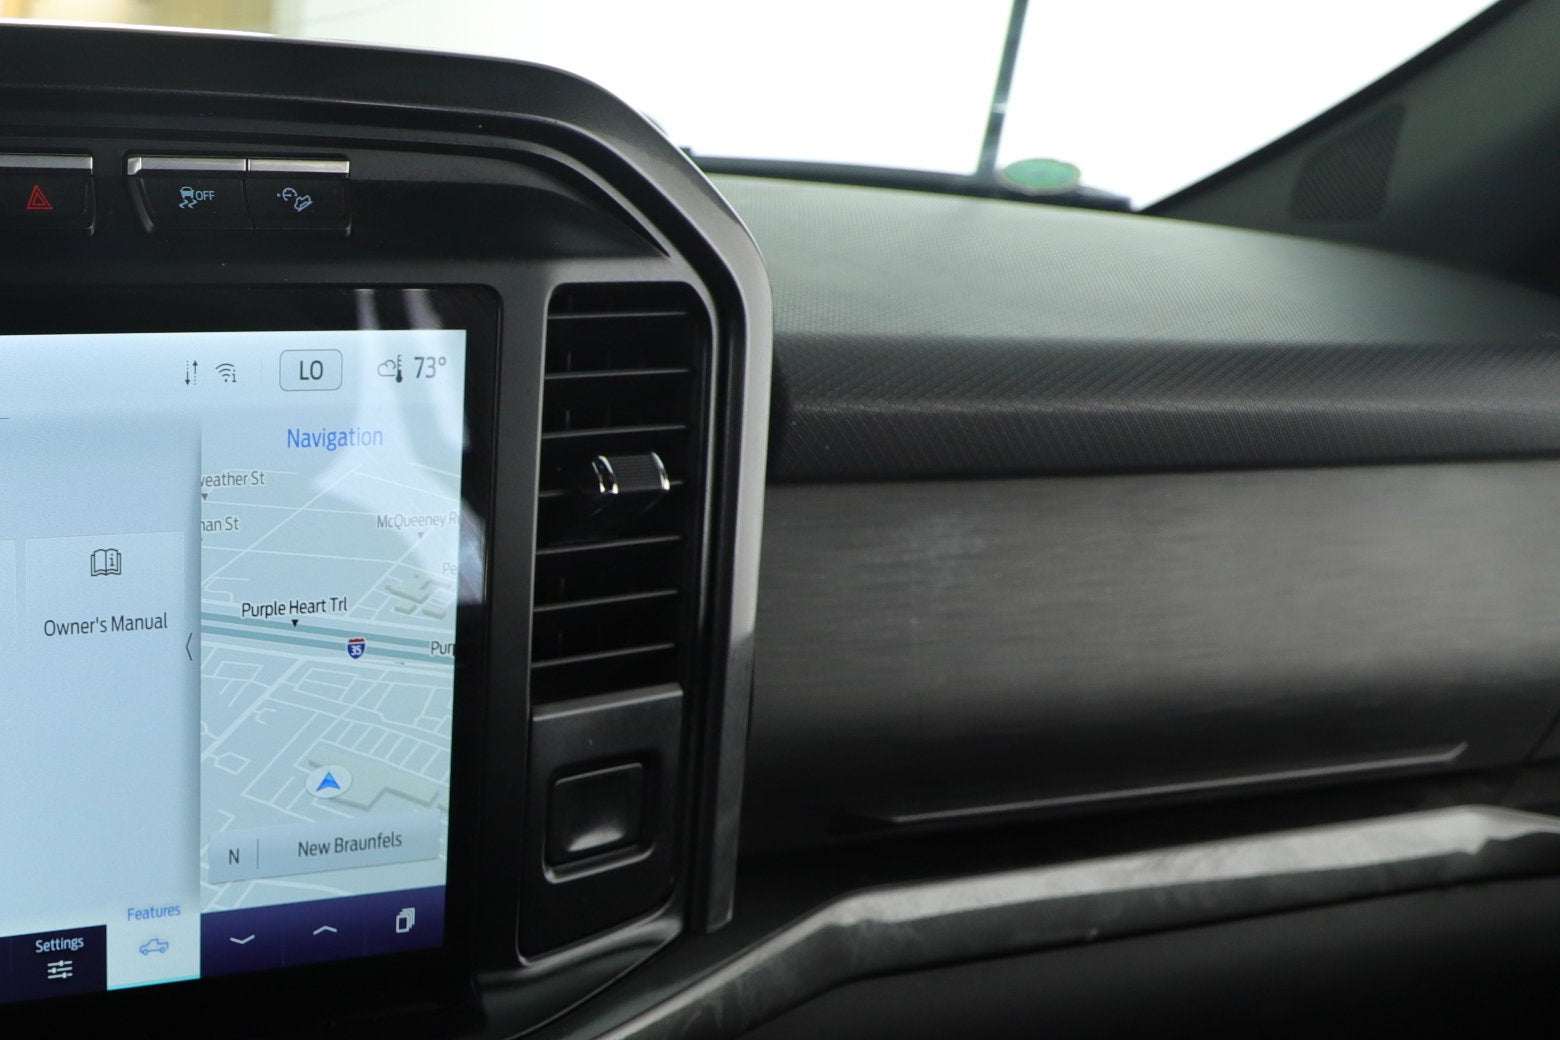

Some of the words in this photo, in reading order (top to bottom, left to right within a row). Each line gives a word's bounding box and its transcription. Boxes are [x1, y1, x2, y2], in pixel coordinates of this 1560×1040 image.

[195, 190, 215, 201] OFF
[298, 359, 324, 381] LO
[413, 355, 448, 379] 73°
[286, 426, 383, 451] Navigation
[250, 470, 265, 486] St
[224, 516, 239, 531] St
[376, 513, 446, 531] McQueeney
[241, 602, 286, 619] Purple
[290, 600, 326, 615] Heart
[330, 597, 347, 612] Trl
[43, 615, 108, 638] Owner's
[110, 612, 168, 634] Manual
[351, 644, 362, 656] 35
[297, 838, 330, 858] New
[333, 832, 403, 856] Braunfels
[228, 848, 240, 865] N
[127, 902, 181, 922] Features
[35, 935, 84, 954] Settings
